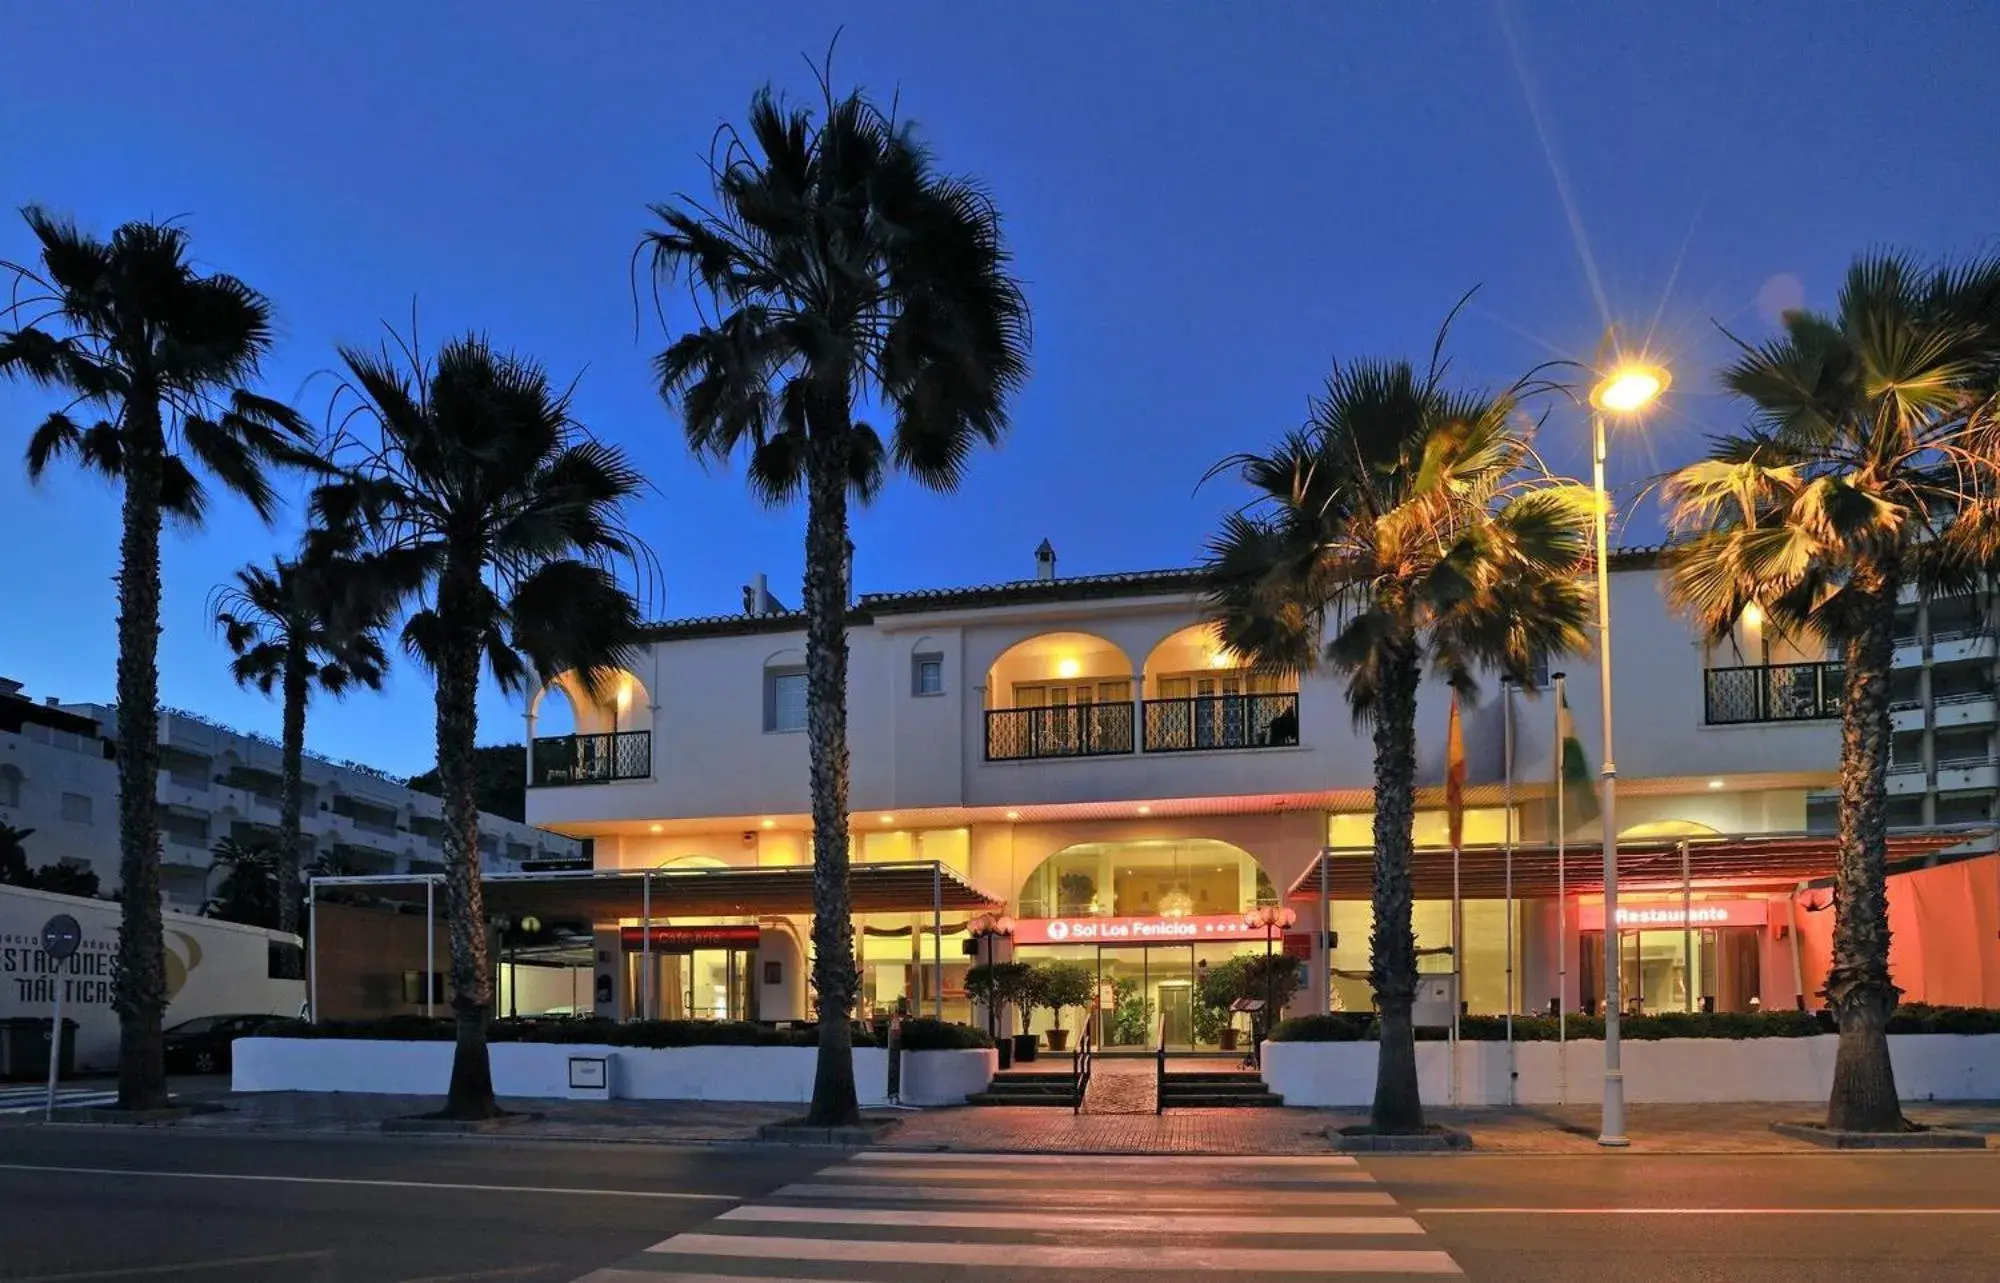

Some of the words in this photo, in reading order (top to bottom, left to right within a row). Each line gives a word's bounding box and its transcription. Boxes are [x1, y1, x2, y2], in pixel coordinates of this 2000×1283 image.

[1072, 923, 1098, 937] Sol
[1100, 923, 1129, 937] Los
[1133, 920, 1197, 936] Fenicios
